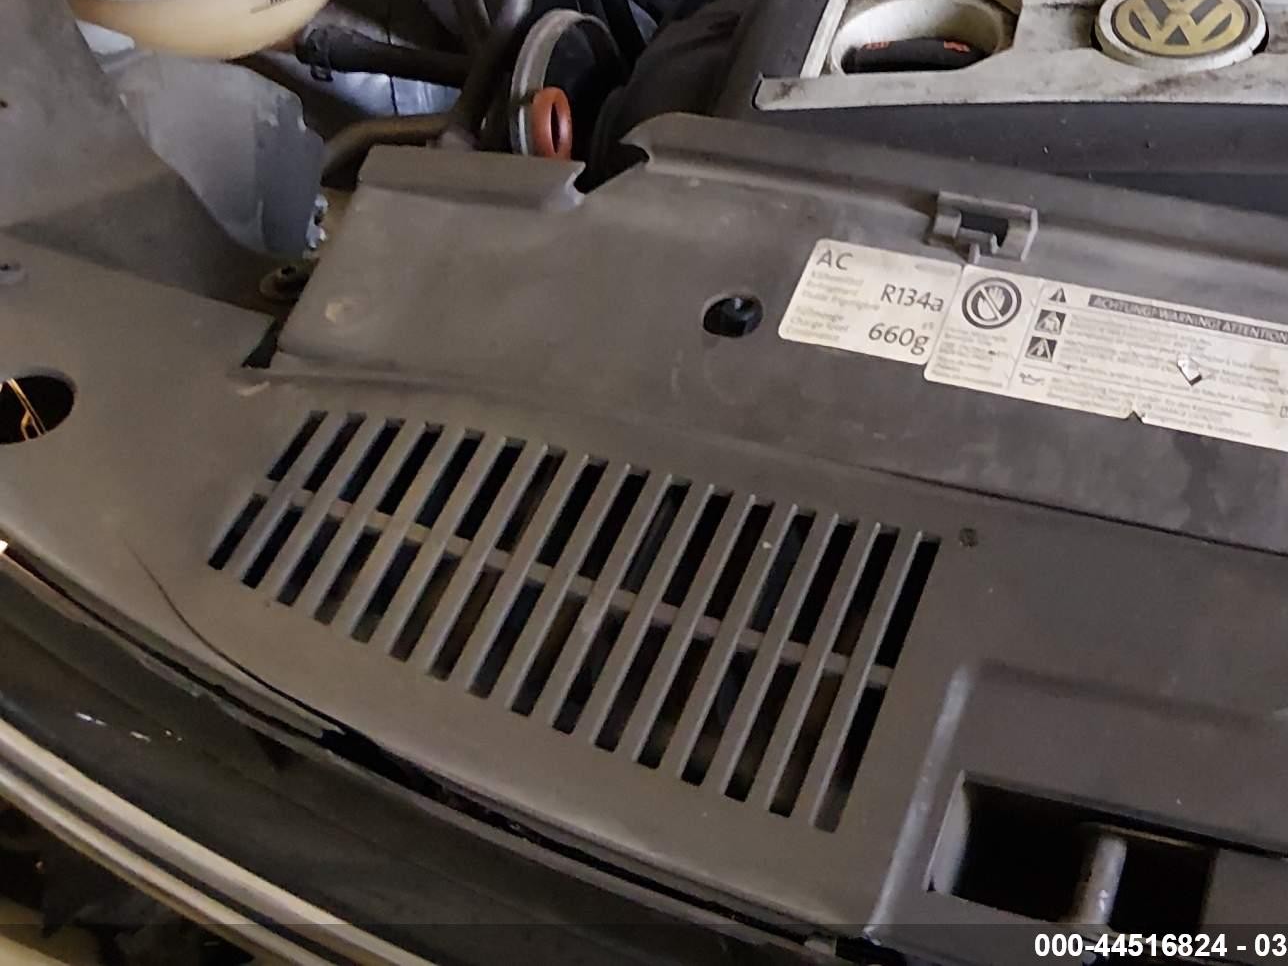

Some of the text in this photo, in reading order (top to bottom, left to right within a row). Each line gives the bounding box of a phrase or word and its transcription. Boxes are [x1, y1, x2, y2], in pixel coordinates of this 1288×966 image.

[816, 248, 854, 272] AC
[880, 283, 945, 313] R134a
[867, 322, 931, 356] 660g
